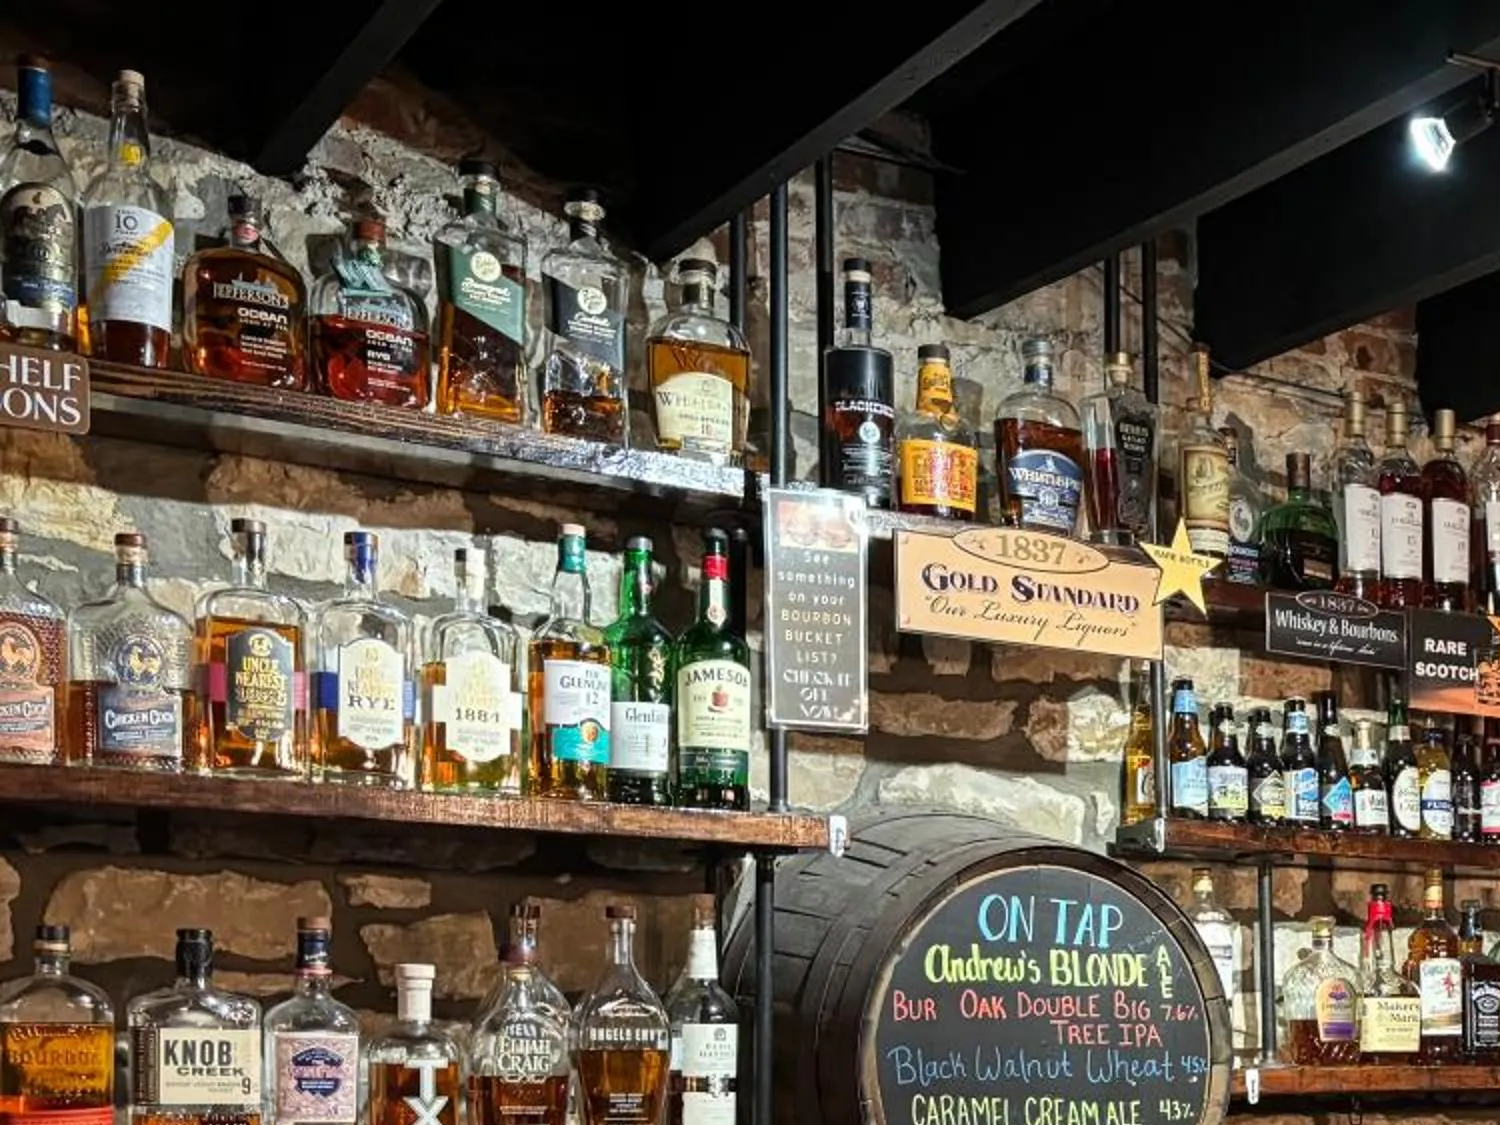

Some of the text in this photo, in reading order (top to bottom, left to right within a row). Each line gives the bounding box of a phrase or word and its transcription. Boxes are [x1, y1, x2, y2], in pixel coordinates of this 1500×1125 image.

[804, 552, 830, 565] See
[996, 535, 1067, 565] 1837
[777, 571, 855, 588] something
[921, 562, 1140, 614] GOLD STANDARD
[788, 591, 845, 606] on your
[1320, 595, 1356, 612] 1837
[781, 608, 851, 626] BOURBON
[973, 599, 1049, 640] Luxury
[1275, 608, 1398, 643] Whiskey & Bourbons
[784, 630, 843, 645] BUCKET
[1424, 637, 1467, 657] RARE
[796, 651, 837, 665] LIST?
[1415, 662, 1479, 681] SCOTCH
[348, 695, 396, 711] RYE
[586, 690, 600, 705] 12
[978, 894, 1123, 949] ON TAP
[924, 943, 1173, 998] Andrew's BLONDE ALE
[893, 990, 937, 1021] BUR
[960, 989, 1007, 1020] OAK
[1017, 992, 1101, 1018] DOUBLE
[1113, 990, 1151, 1020] BIG
[1049, 1019, 1163, 1048] TREE IPA
[164, 1039, 233, 1066] KNOB
[500, 1036, 550, 1055] ELIJAH
[176, 1067, 244, 1077] CREEK
[499, 1053, 550, 1073] CRAIG
[886, 1045, 967, 1087] Black
[975, 1046, 1073, 1083] Walnut
[1086, 1050, 1175, 1085] Wheat
[241, 1077, 251, 1095] 9
